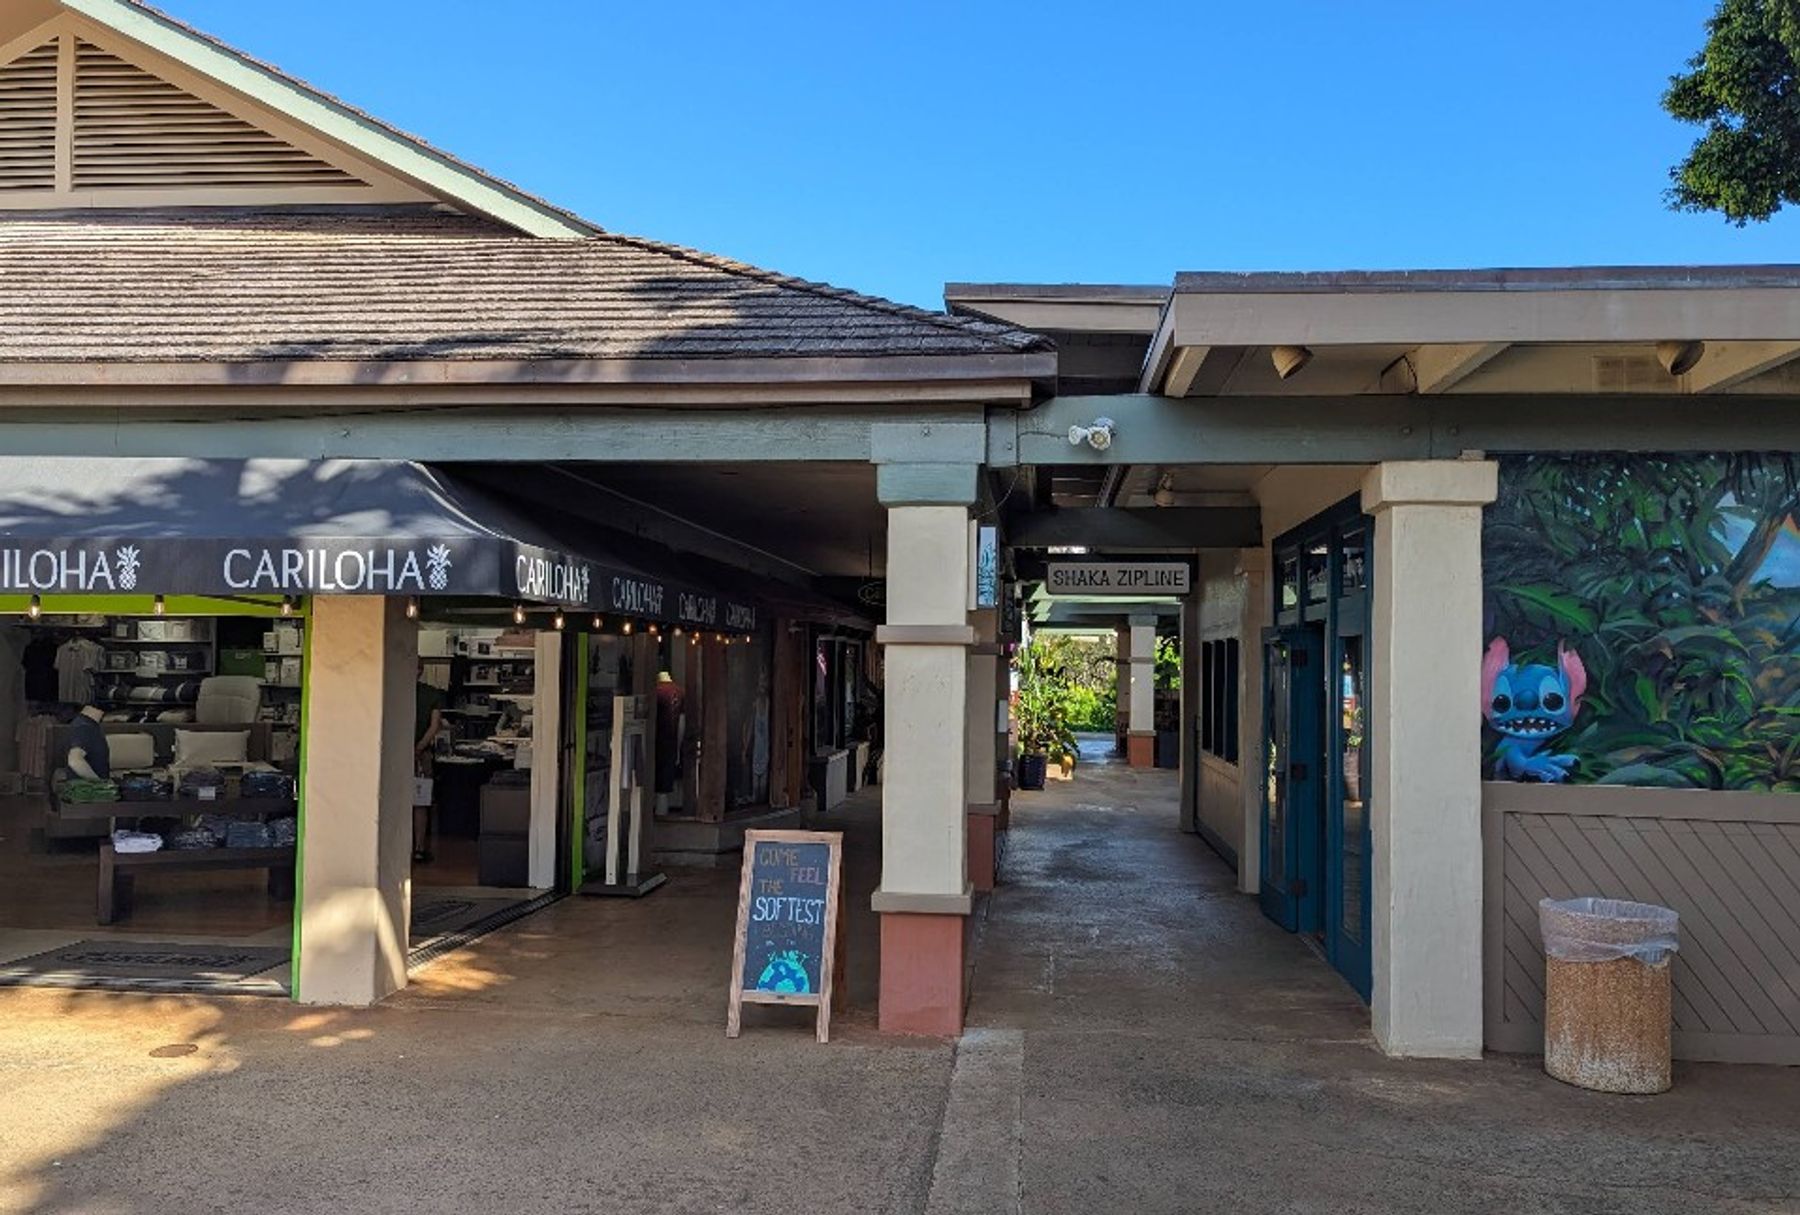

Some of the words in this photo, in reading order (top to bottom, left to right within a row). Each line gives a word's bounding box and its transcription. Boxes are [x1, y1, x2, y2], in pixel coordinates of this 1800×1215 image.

[2, 549, 117, 590] ILOHA
[223, 549, 426, 590] CARILOHA
[515, 555, 582, 601] CARILOHA
[1053, 569, 1110, 586] SHAKA
[1117, 569, 1184, 586] ZIPLINE
[790, 866, 824, 886] FEEL
[752, 896, 825, 925] SOFTEST
